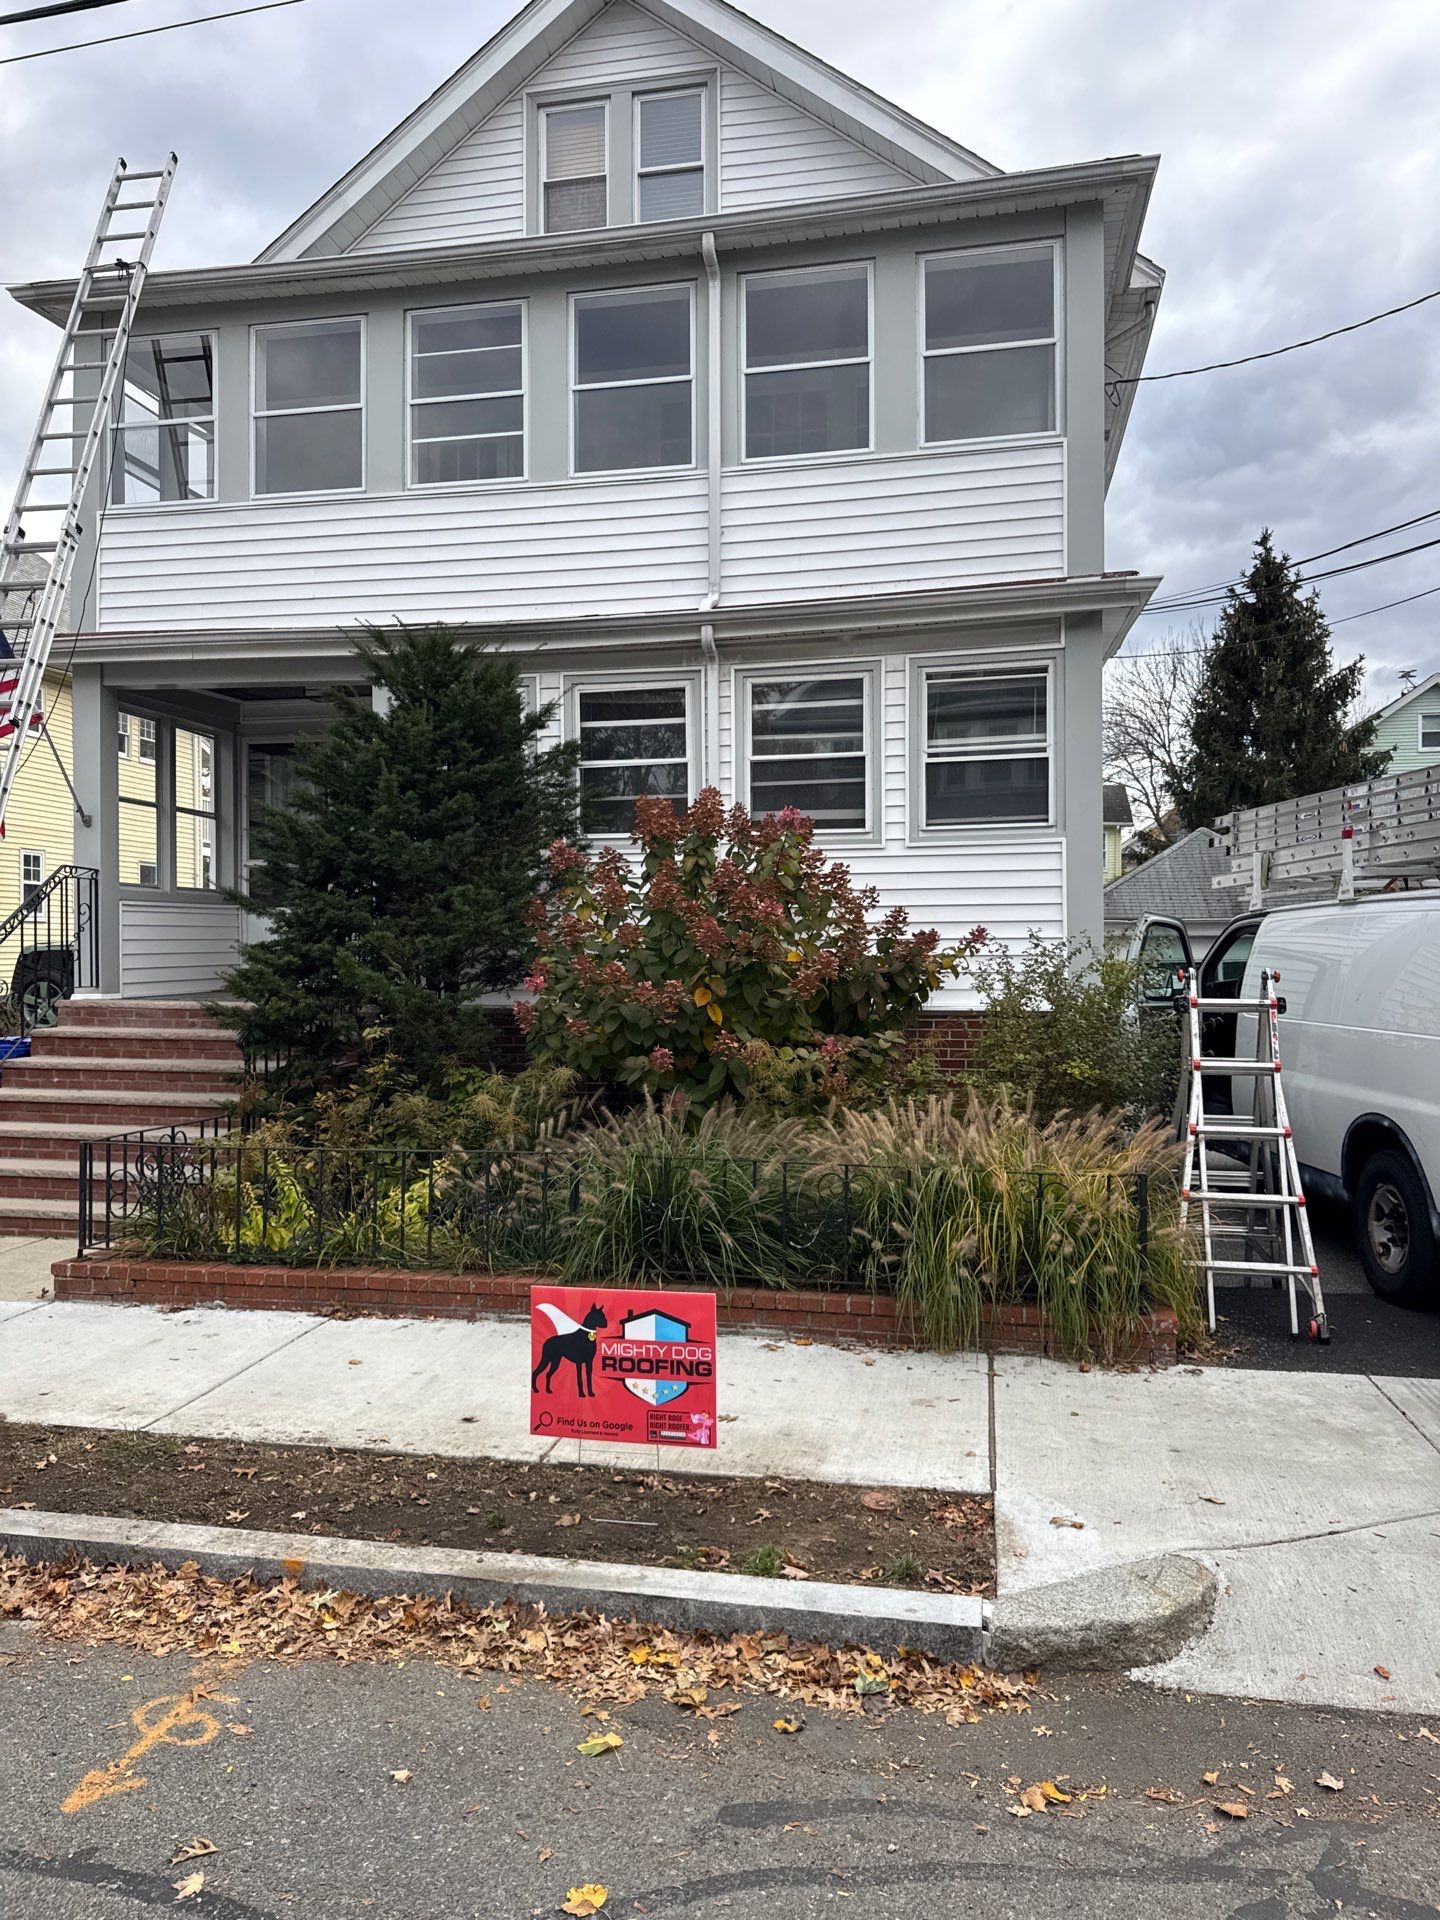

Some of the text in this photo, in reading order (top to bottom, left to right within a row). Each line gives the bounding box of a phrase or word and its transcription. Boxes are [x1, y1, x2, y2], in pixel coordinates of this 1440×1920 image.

[601, 1342, 712, 1361] MIGHTY DOG
[601, 1356, 713, 1377] ROOFING
[557, 1417, 575, 1426] Find
[577, 1419, 588, 1428] Us
[602, 1420, 634, 1432] Google
[649, 1413, 667, 1421] RIGHT
[649, 1422, 667, 1430] RIGHT
